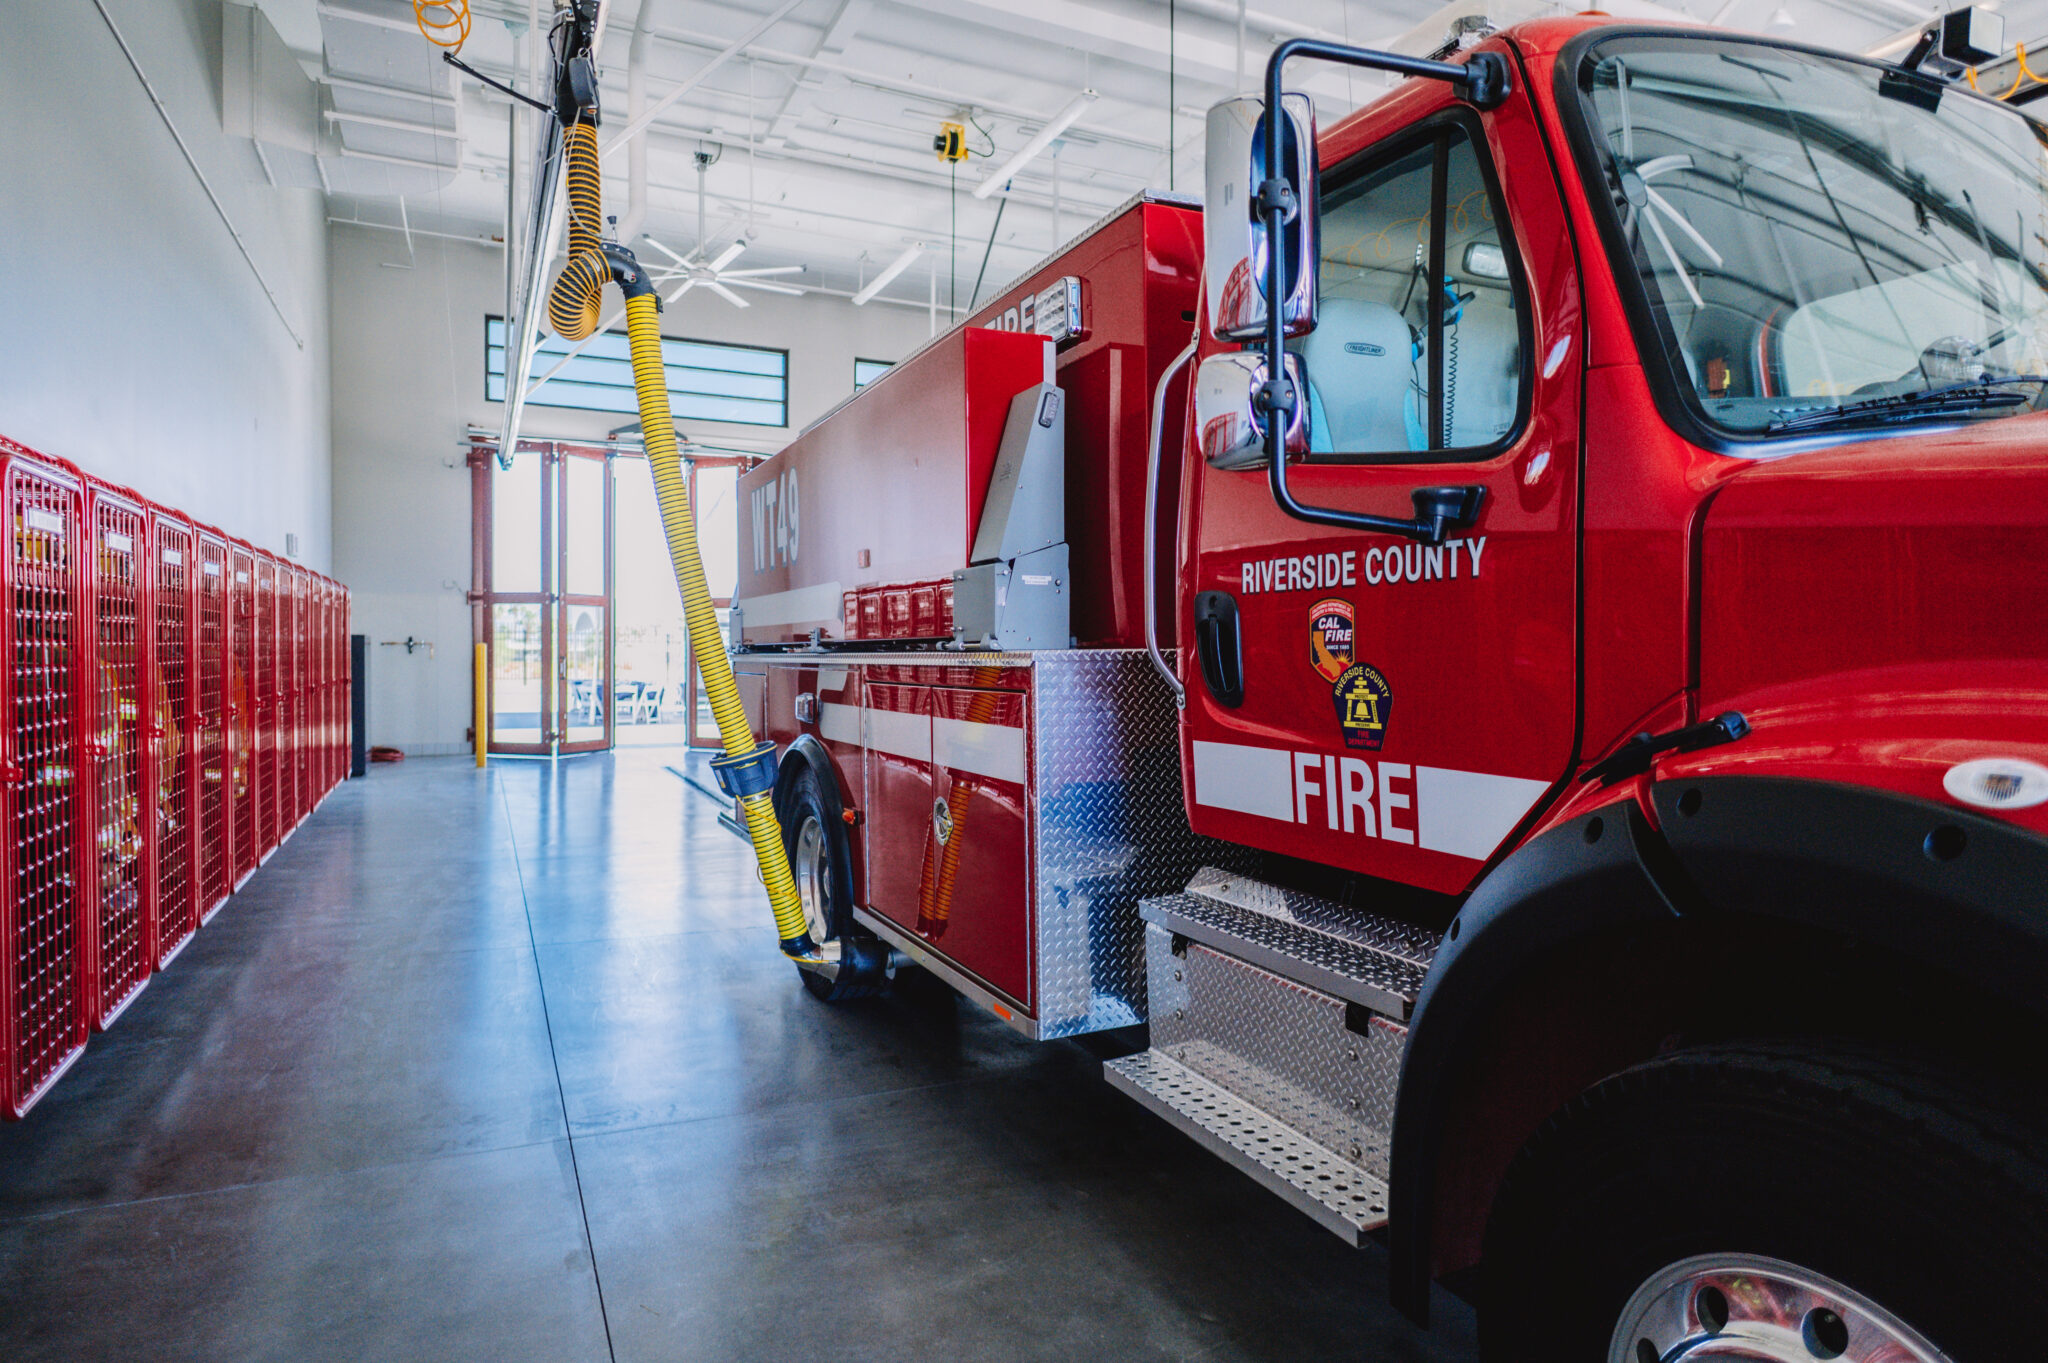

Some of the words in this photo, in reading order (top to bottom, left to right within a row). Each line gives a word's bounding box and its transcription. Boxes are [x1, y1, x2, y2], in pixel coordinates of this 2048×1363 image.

[751, 466, 799, 576] WT49
[1241, 550, 1357, 595] RIVERSIDE
[1365, 536, 1487, 586] COUNTY
[1318, 616, 1340, 630] CAL
[1325, 629, 1353, 642] FIRE
[1335, 666, 1364, 697] RIVERSIDE
[1364, 667, 1390, 698] COUNTY
[1294, 751, 1415, 846] FIRE
